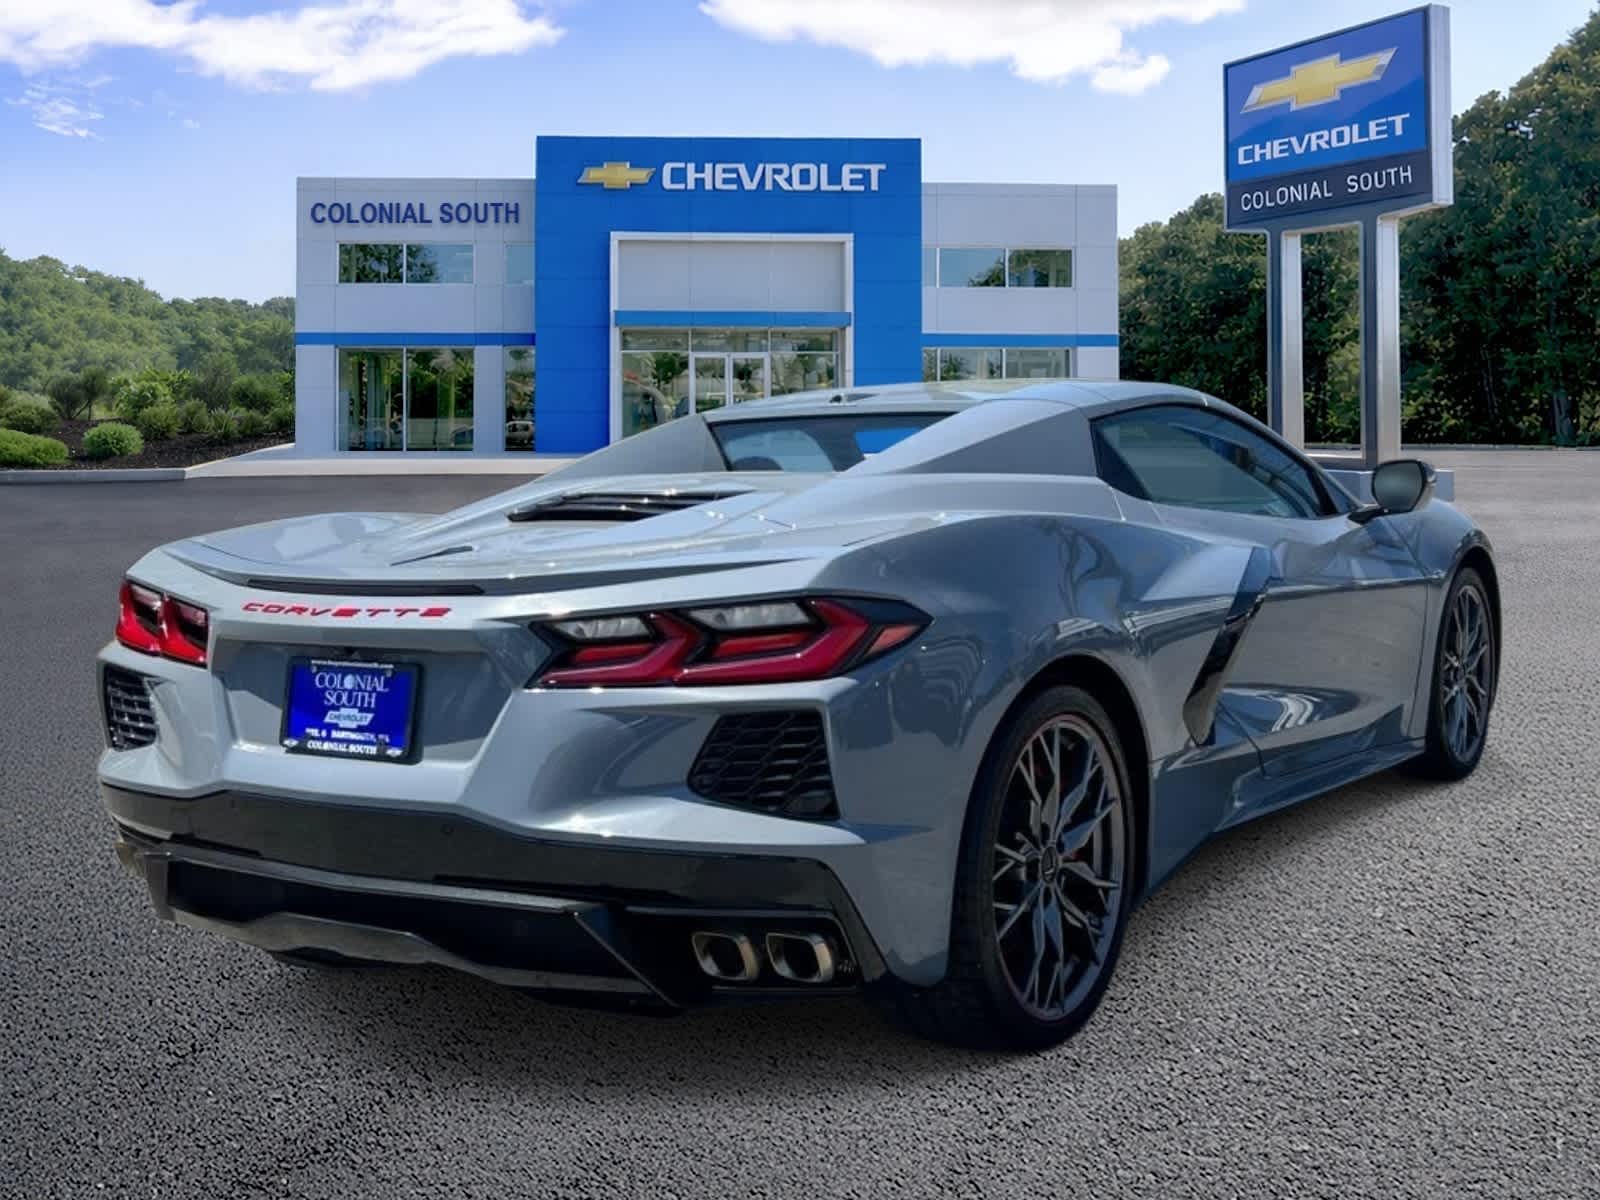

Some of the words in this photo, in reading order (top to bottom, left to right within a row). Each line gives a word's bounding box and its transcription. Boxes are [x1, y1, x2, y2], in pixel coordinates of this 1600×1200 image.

[1238, 113, 1410, 165] CHEVROLET
[662, 162, 887, 192] CHEVROLET
[1241, 180, 1333, 211] COLONIAL
[1346, 165, 1412, 194] SOUTH
[310, 202, 433, 224] COLONIAL
[439, 202, 520, 224] SOUTH
[242, 602, 452, 617] CORVETTE
[315, 671, 390, 693] COLONIAL
[323, 690, 377, 709] SOUTH
